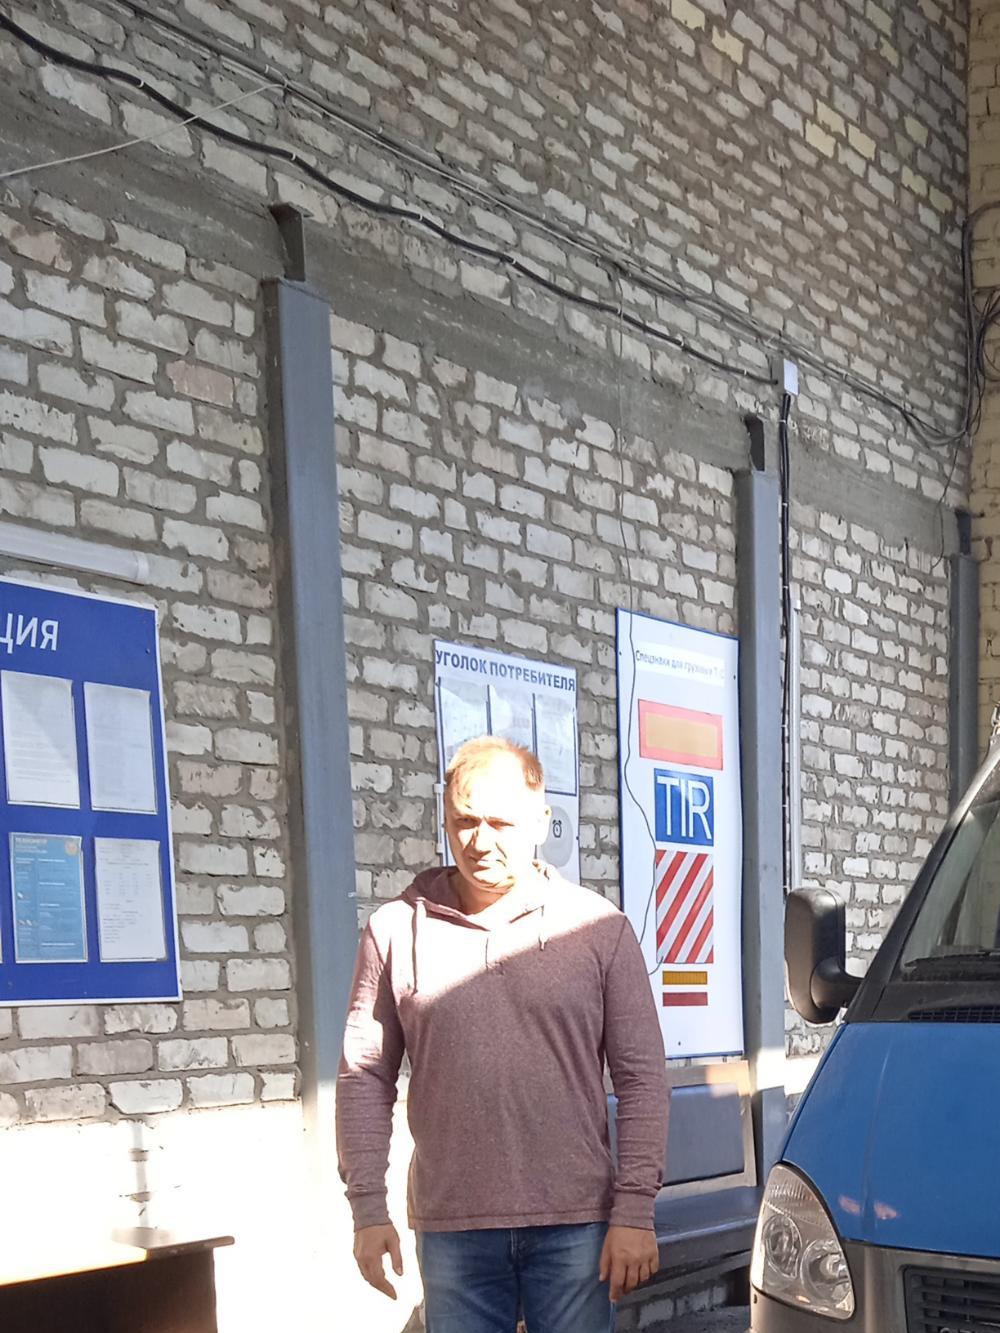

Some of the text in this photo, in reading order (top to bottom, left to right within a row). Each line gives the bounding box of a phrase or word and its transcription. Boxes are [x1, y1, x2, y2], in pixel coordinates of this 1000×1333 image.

[436, 649, 576, 692] УГОЛОК ПОТРЕБИТЕЛЯ
[656, 775, 712, 840] TIR
